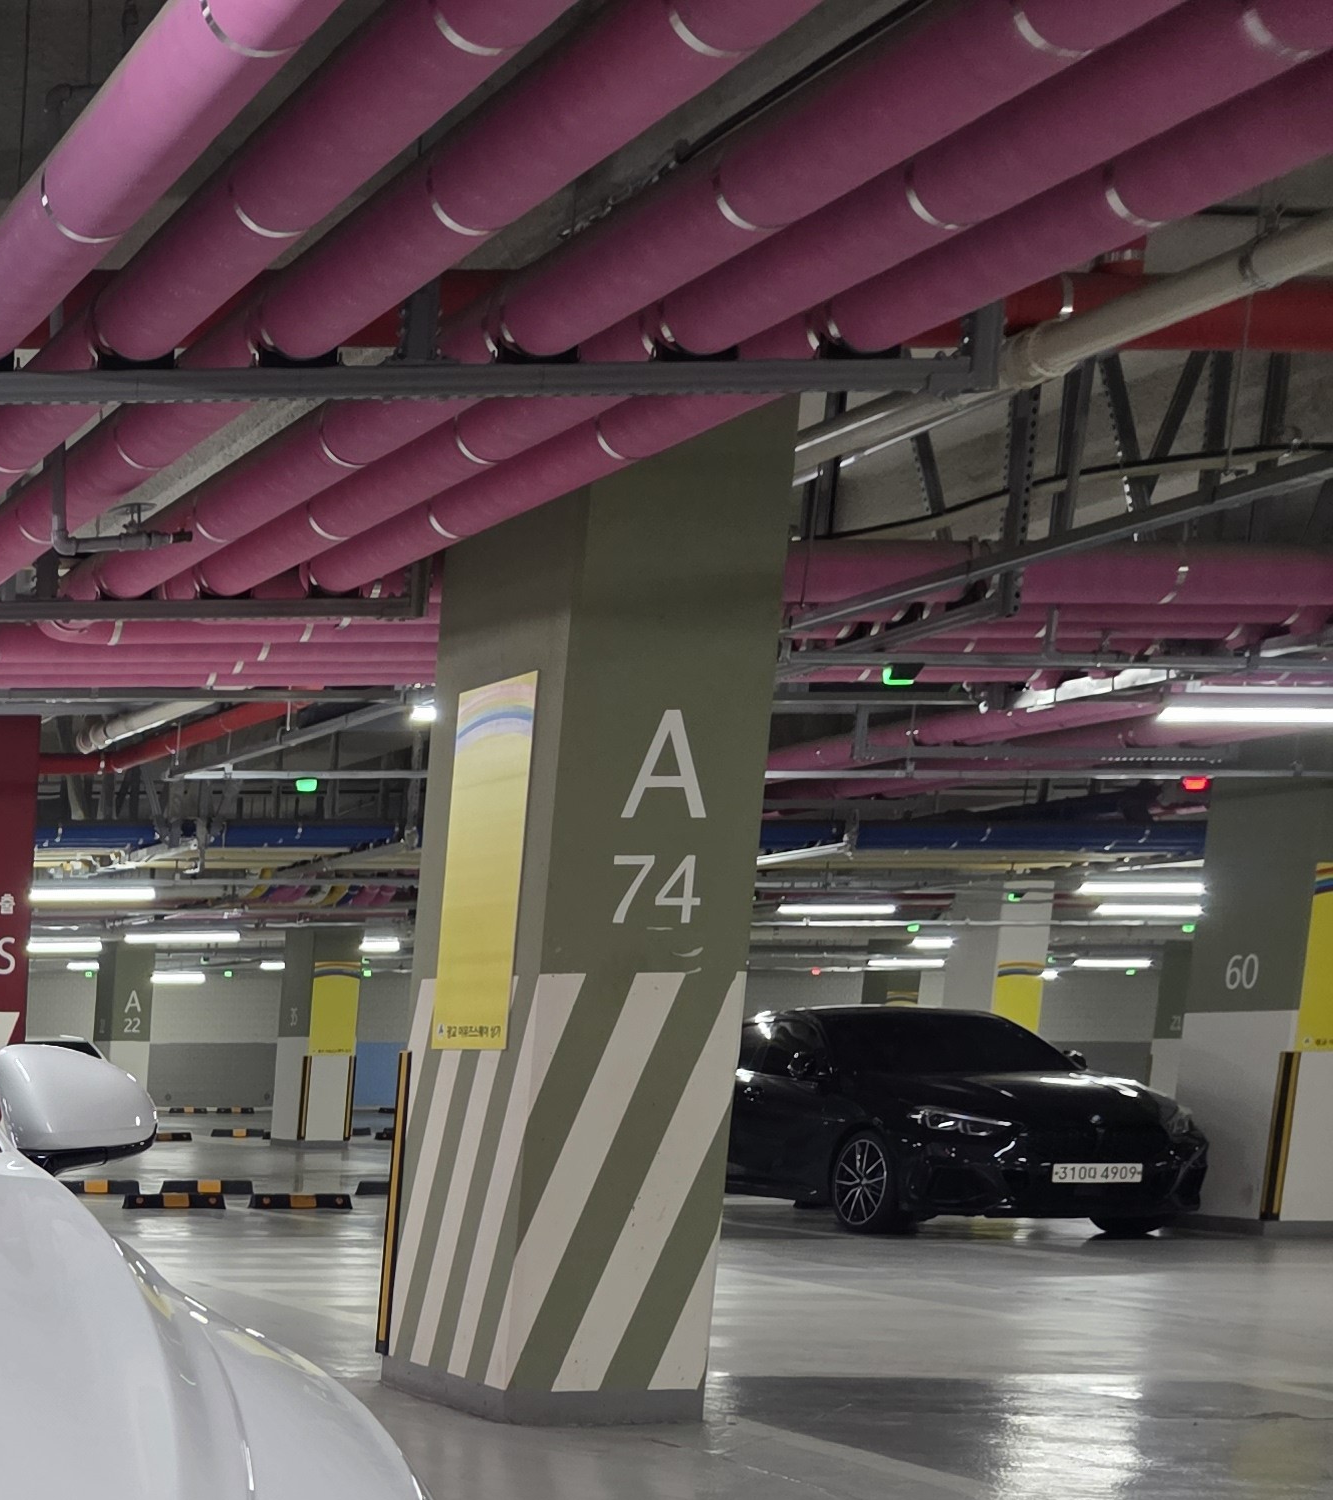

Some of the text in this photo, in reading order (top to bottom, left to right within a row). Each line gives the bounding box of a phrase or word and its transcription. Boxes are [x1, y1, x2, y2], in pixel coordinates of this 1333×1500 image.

[620, 709, 707, 819] A
[612, 854, 701, 924] 74
[1225, 953, 1259, 990] 60
[124, 990, 142, 1014] A
[123, 1017, 141, 1033] 22
[1100, 1165, 1137, 1180] 4909
